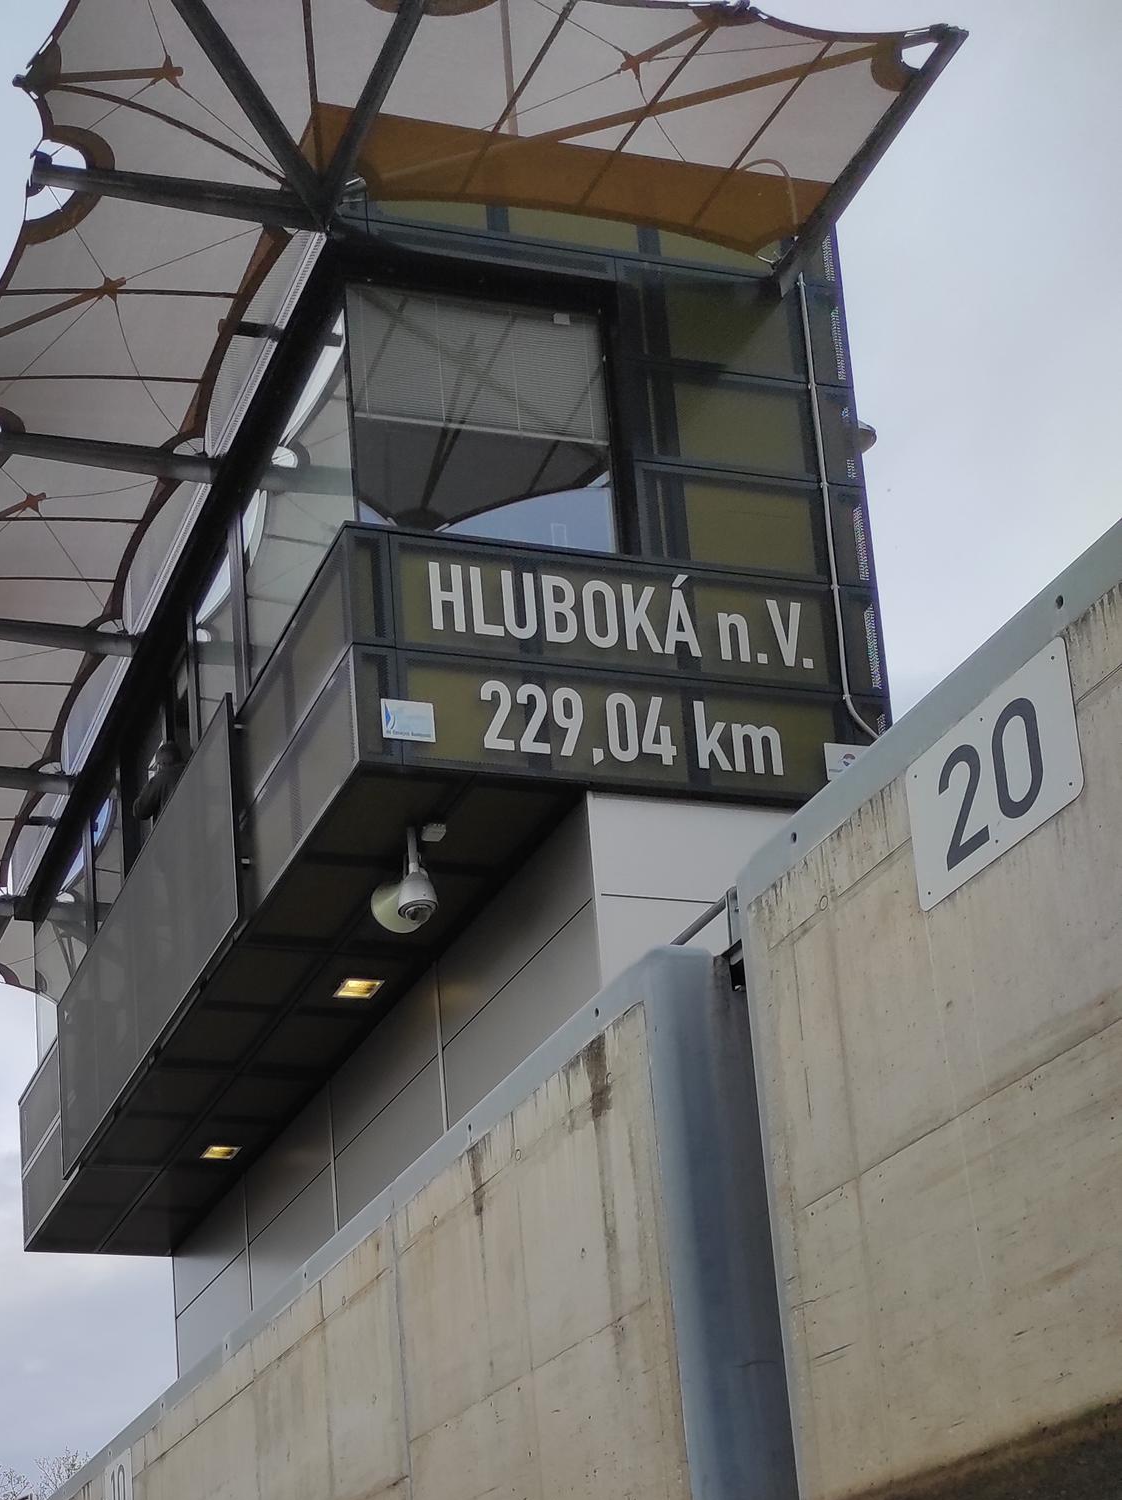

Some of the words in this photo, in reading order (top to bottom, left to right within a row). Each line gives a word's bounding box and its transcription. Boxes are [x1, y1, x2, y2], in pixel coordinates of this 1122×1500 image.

[428, 561, 703, 658] HLUBOKÁ
[717, 599, 814, 669] n.V.
[480, 680, 677, 767] 229,04
[693, 700, 784, 776] km
[938, 697, 1044, 872] 20
